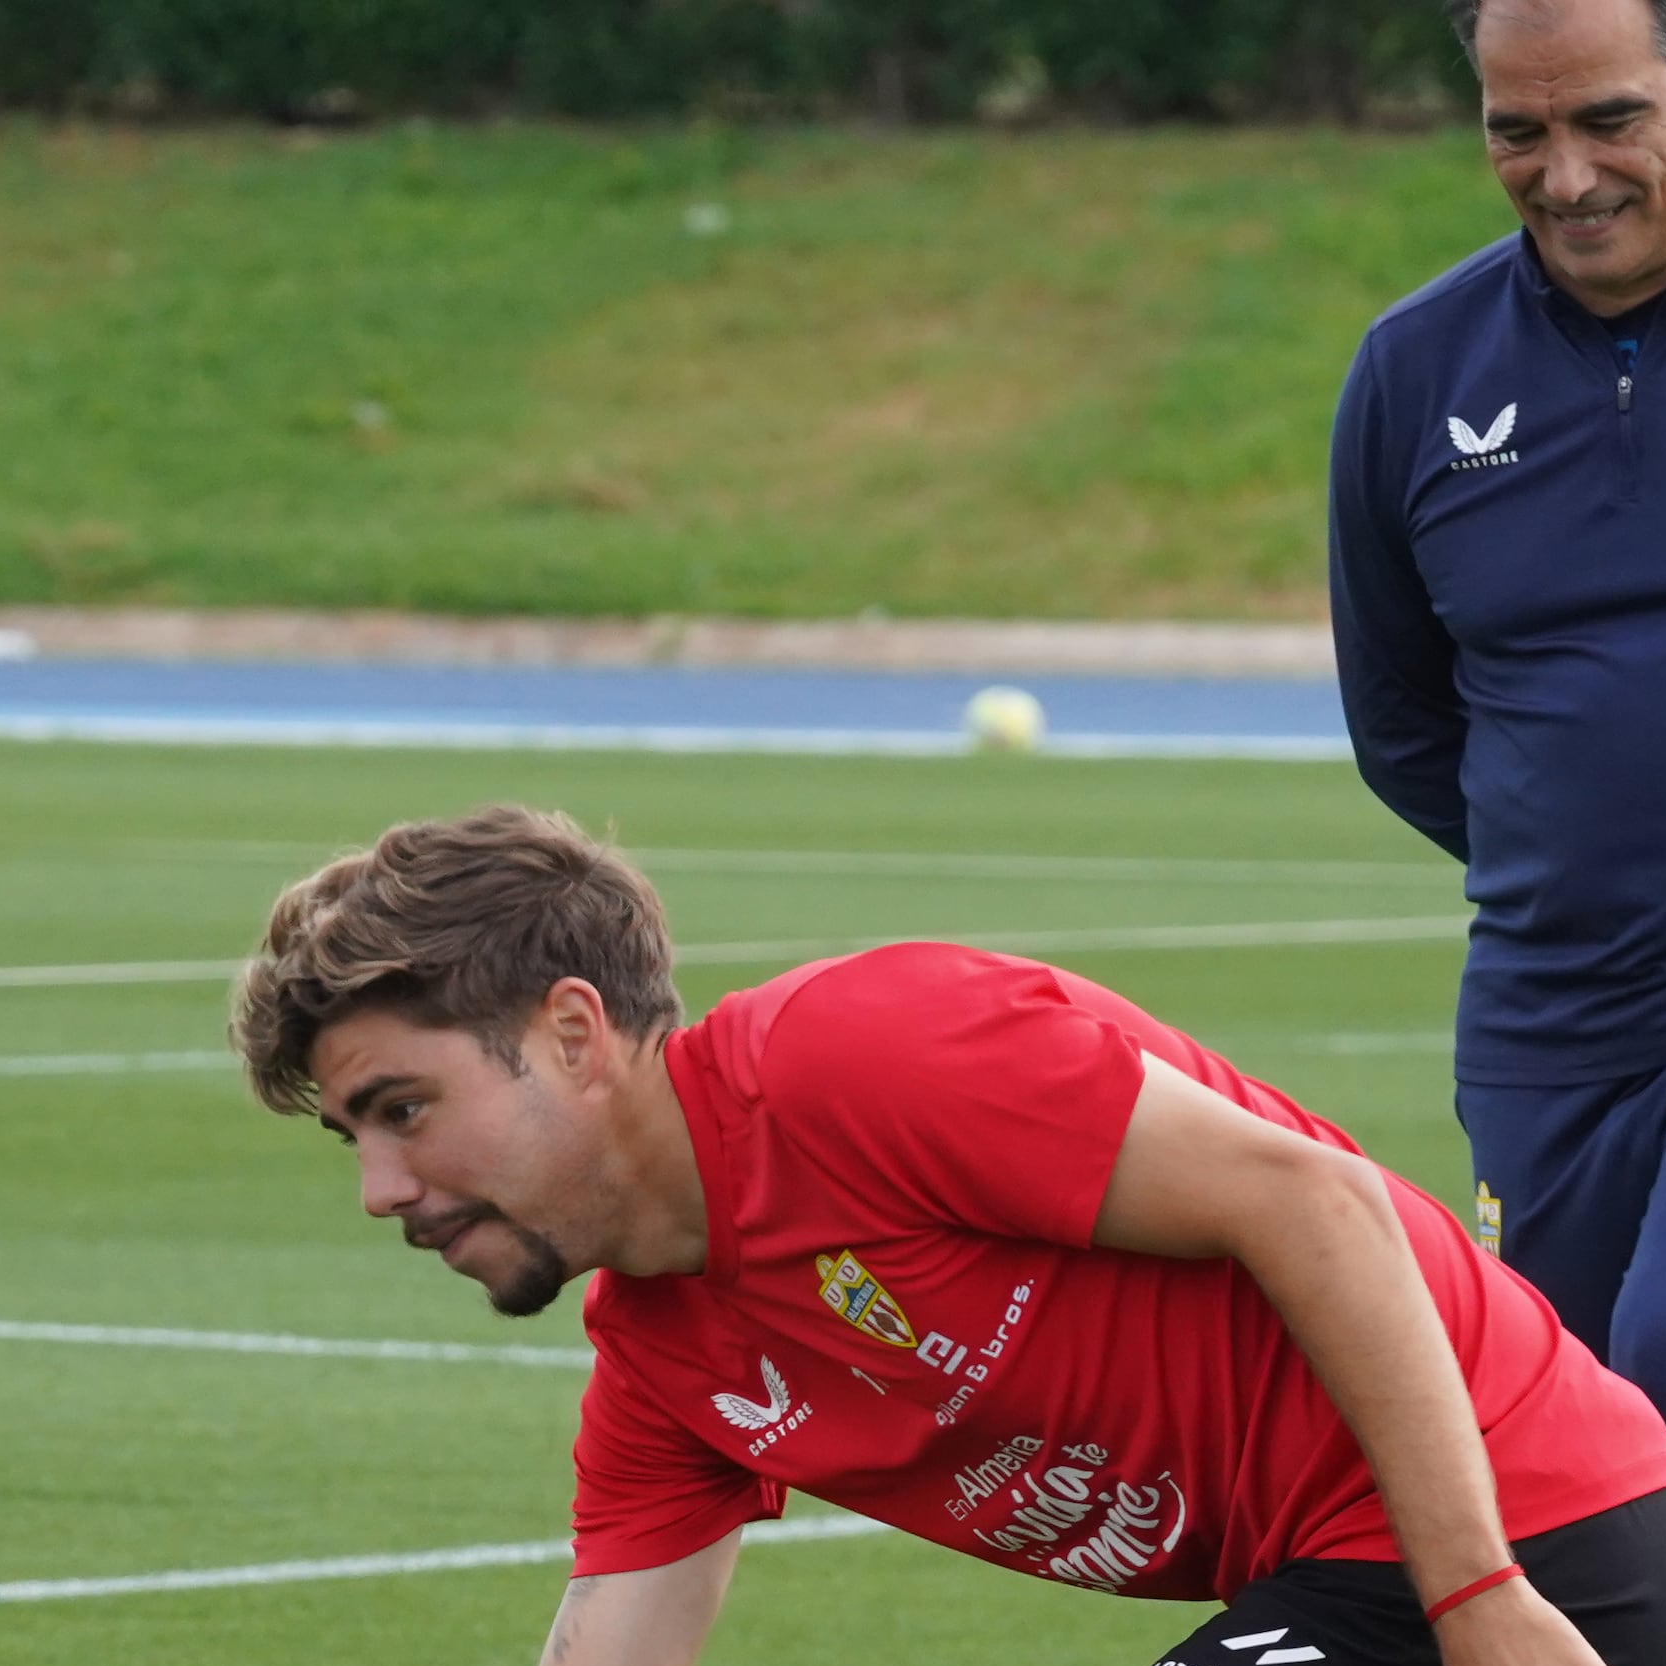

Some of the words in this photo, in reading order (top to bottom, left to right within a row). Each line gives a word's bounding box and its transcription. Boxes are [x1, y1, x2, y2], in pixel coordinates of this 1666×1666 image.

[935, 1385, 975, 1425] ajlan
[965, 1364, 988, 1382] &
[979, 1279, 1035, 1359] bros.
[748, 1401, 813, 1457] CASTORE
[944, 1499, 973, 1521] En
[1005, 1466, 1095, 1542] vida
[1062, 1442, 1108, 1466] te
